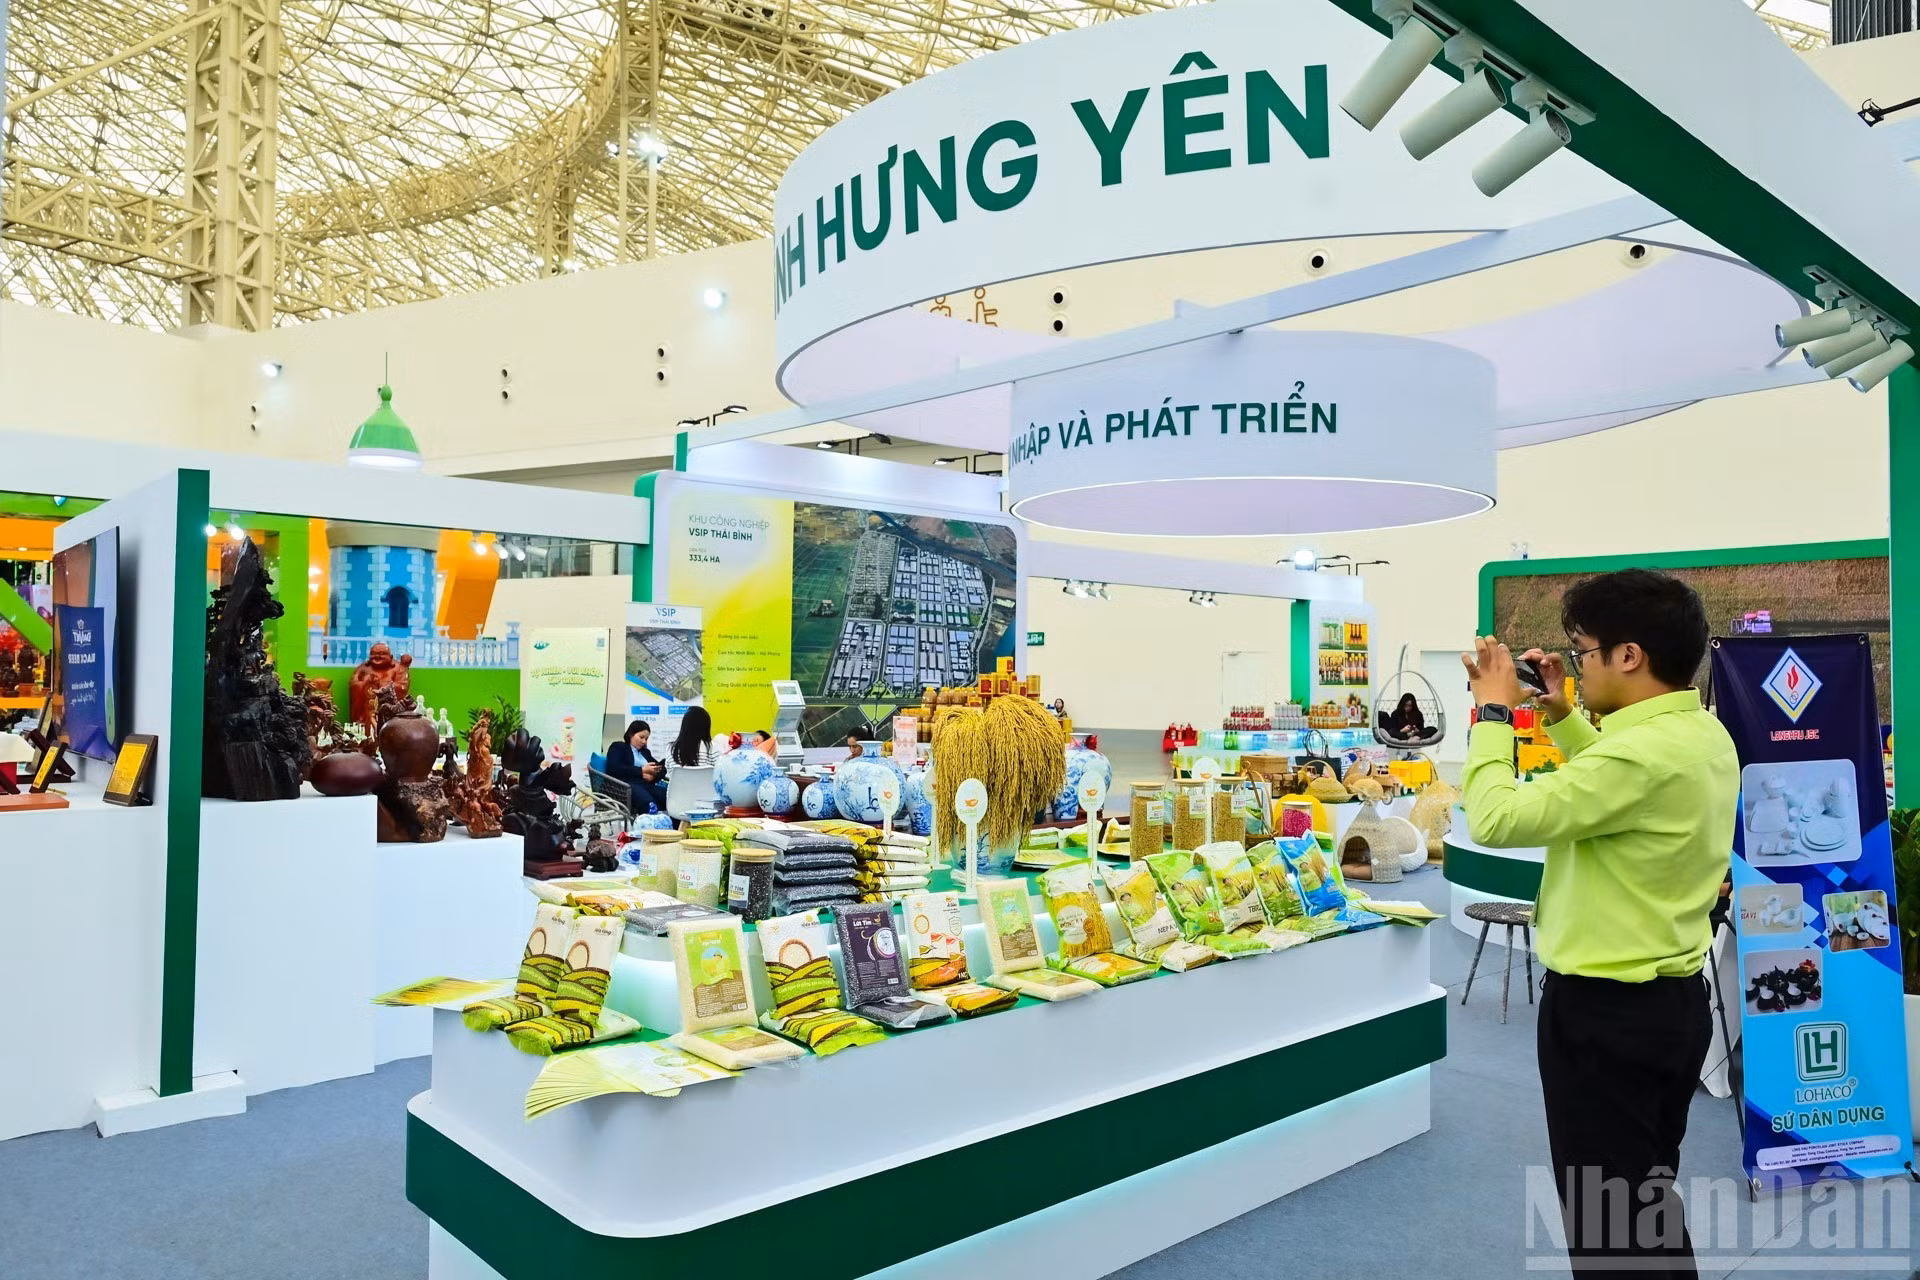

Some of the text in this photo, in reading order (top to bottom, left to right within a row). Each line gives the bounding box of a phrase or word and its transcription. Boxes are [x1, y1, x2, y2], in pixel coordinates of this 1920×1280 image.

[816, 119, 1038, 274] HƯNG
[1070, 50, 1330, 187] YÊN
[1012, 422, 1050, 467] NHẬP
[1059, 409, 1093, 449] VÀ
[1105, 397, 1200, 443] PHÁT
[1212, 381, 1337, 434] TRIỂN
[689, 514, 707, 525] KHU
[689, 528, 752, 541] VSIP THÁI BÌNH
[655, 607, 676, 617] VSIP
[1772, 1106, 1885, 1131] SỨ DÂN DỤNG
